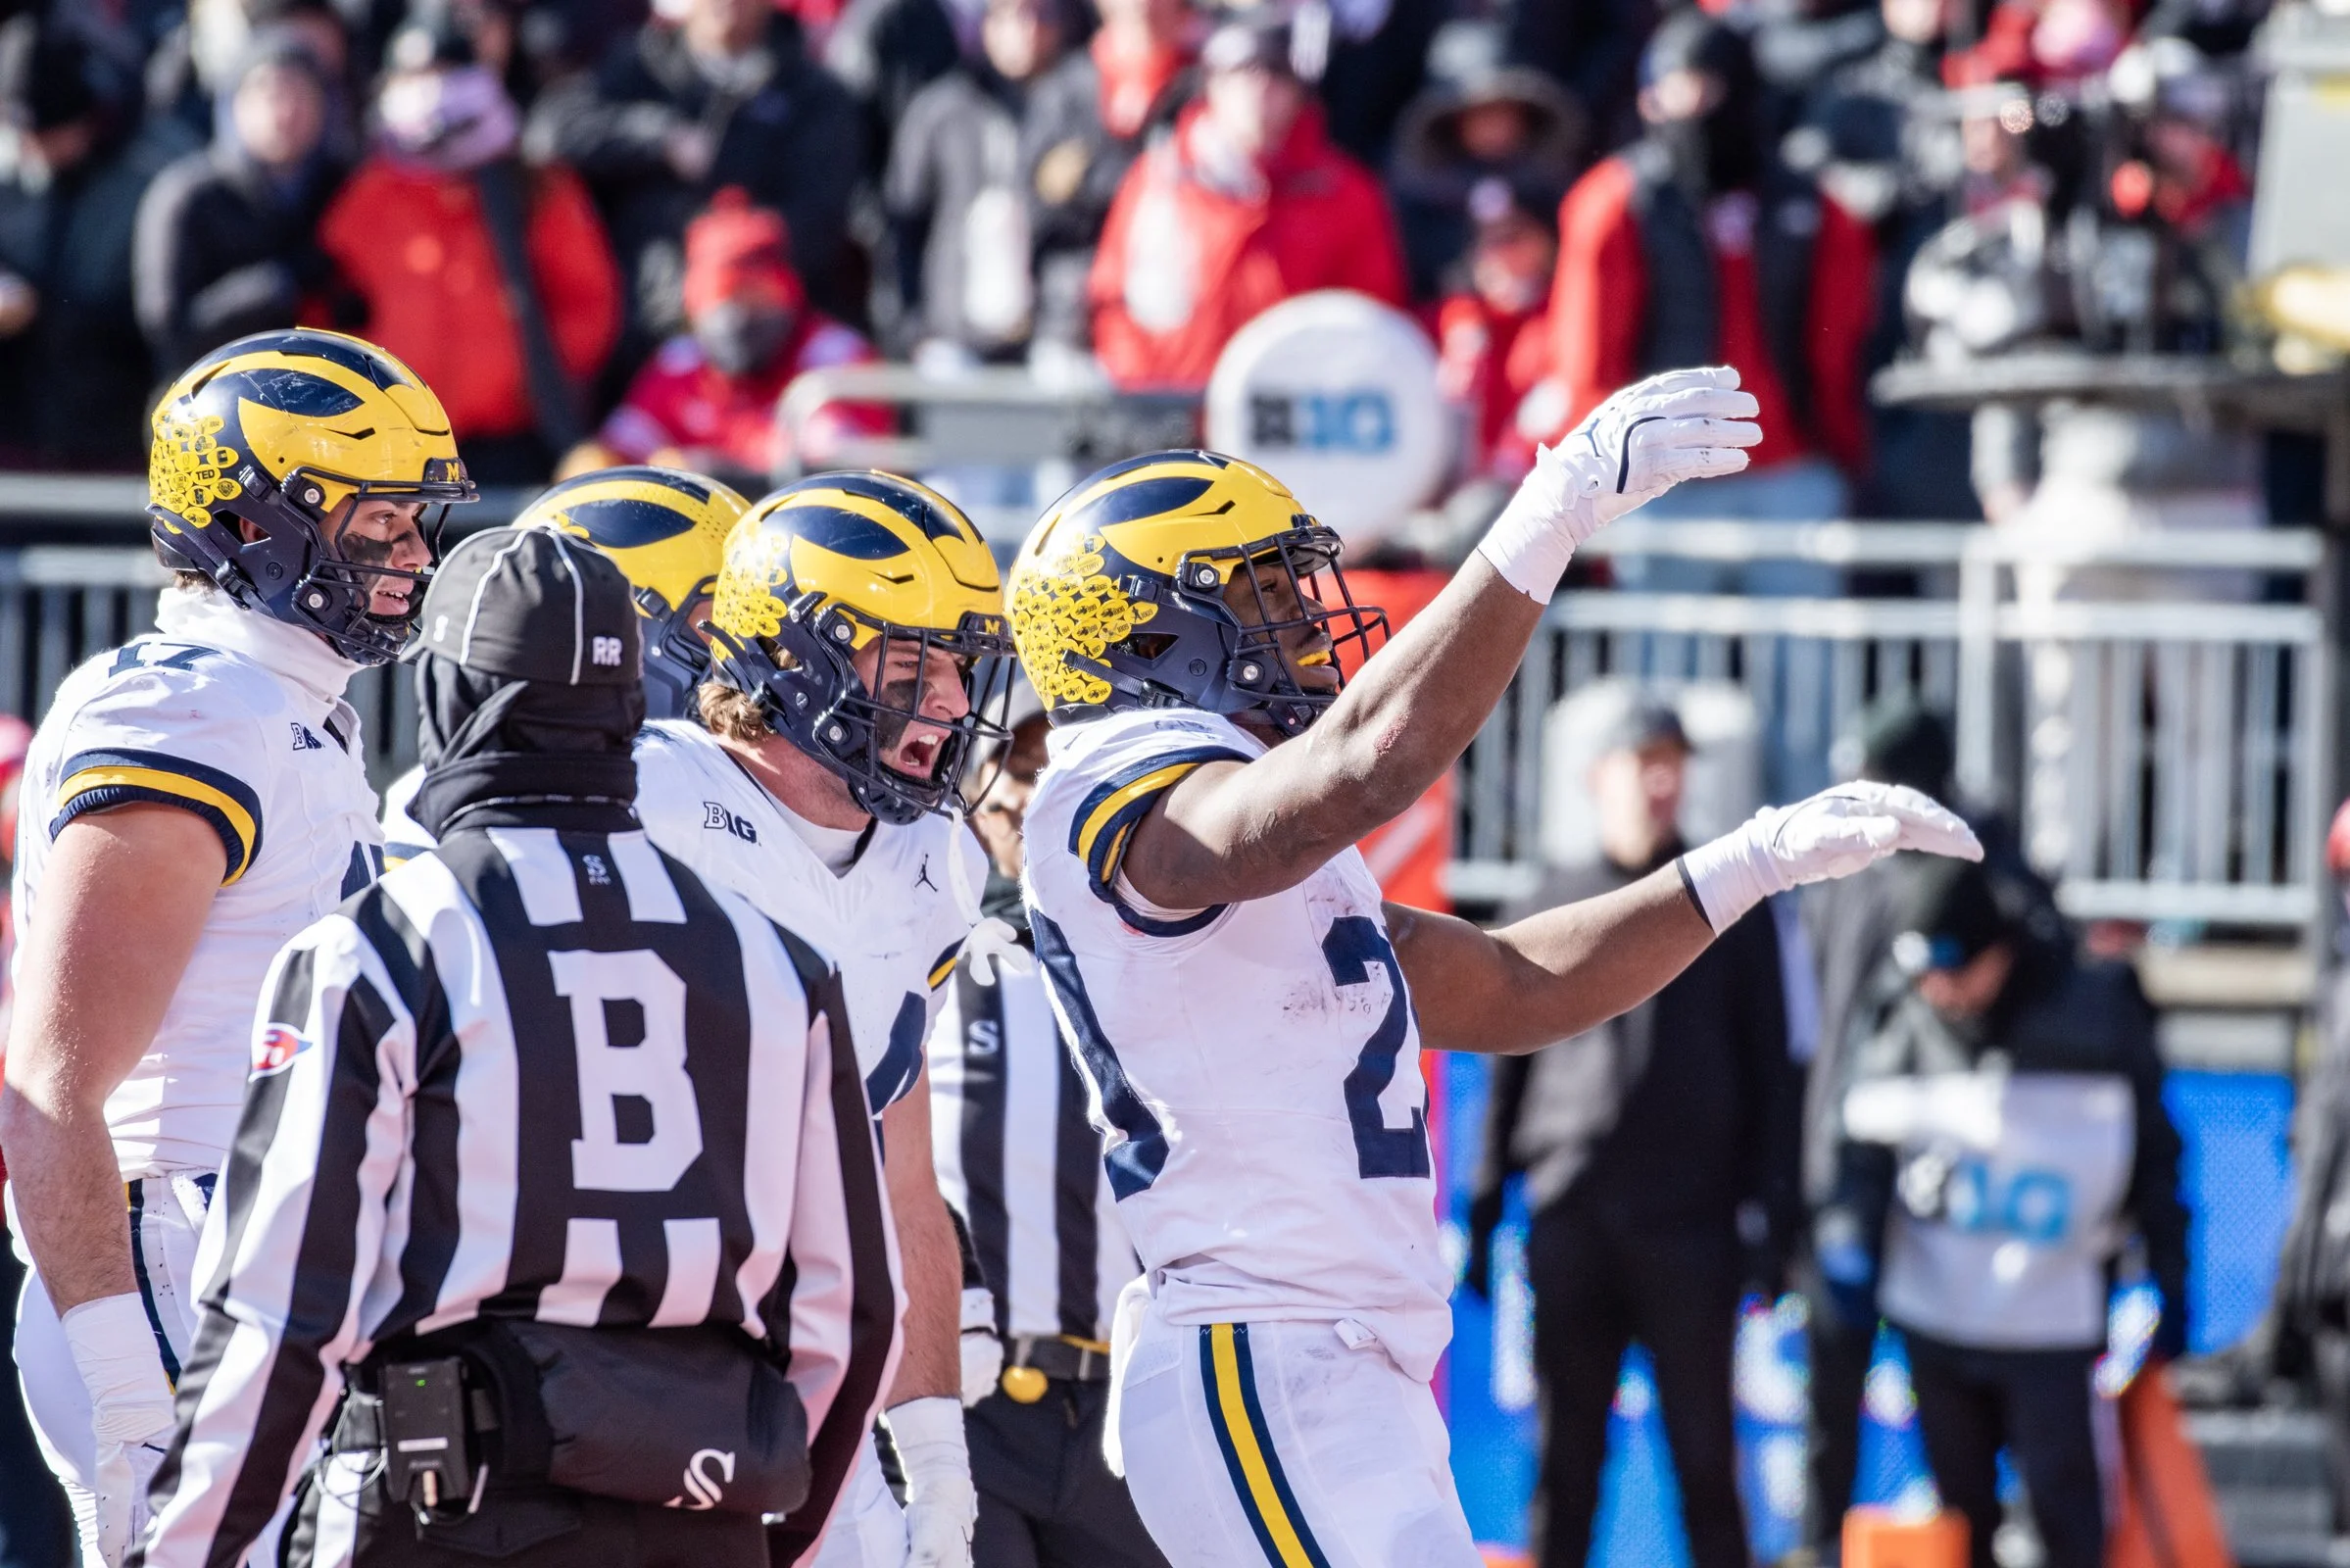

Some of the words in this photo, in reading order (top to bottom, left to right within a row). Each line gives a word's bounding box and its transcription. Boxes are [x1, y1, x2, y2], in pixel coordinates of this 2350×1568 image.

[196, 469, 216, 480] TED
[446, 462, 460, 482] M
[984, 618, 1001, 635] M
[593, 636, 622, 665] RR
[968, 1019, 999, 1056] S
[547, 948, 704, 1192] B
